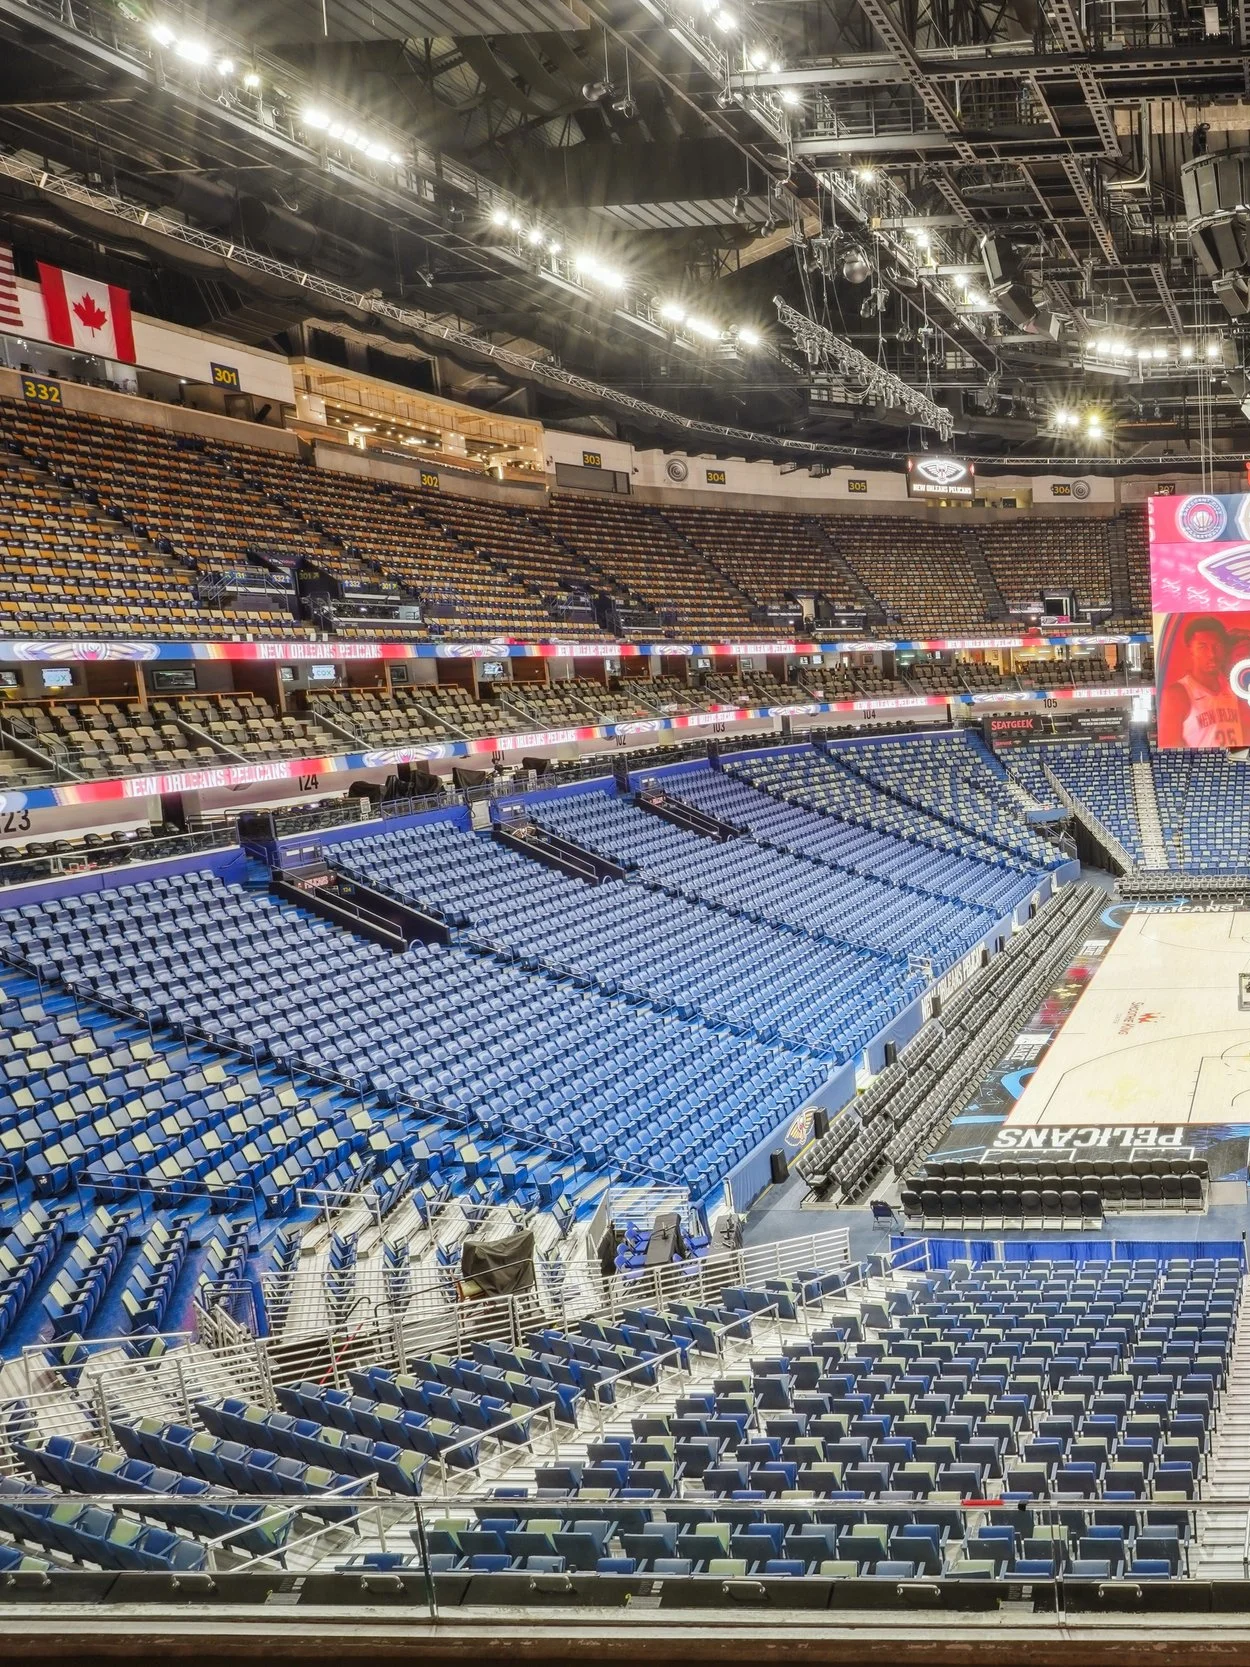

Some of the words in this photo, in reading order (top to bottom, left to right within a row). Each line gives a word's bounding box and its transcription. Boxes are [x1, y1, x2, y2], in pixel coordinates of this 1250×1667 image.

[214, 367, 237, 385] 301
[25, 381, 60, 402] 332
[584, 454, 600, 465] 303
[421, 473, 439, 487] 302
[708, 472, 725, 482] 304
[849, 482, 866, 491] 305
[913, 483, 925, 492] NEW
[926, 484, 948, 493] ORLEANS
[949, 485, 971, 494] PELICANS
[1054, 485, 1070, 494] 306
[260, 643, 285, 659] NEW
[290, 644, 335, 659] ORLEANS
[340, 644, 382, 659] PELICANS
[316, 669, 332, 678] COX
[1043, 698, 1058, 709] 105
[863, 709, 876, 720] 104
[712, 723, 726, 734] 103
[991, 719, 1033, 731] SEATGEEK
[122, 776, 158, 797] NEW
[163, 769, 225, 793] ORLEANS
[228, 762, 288, 786] PELICANS
[299, 774, 319, 792] 124
[0, 809, 31, 833] 23
[1132, 904, 1234, 914] PELICANS
[992, 1126, 1185, 1148] PELICANS
